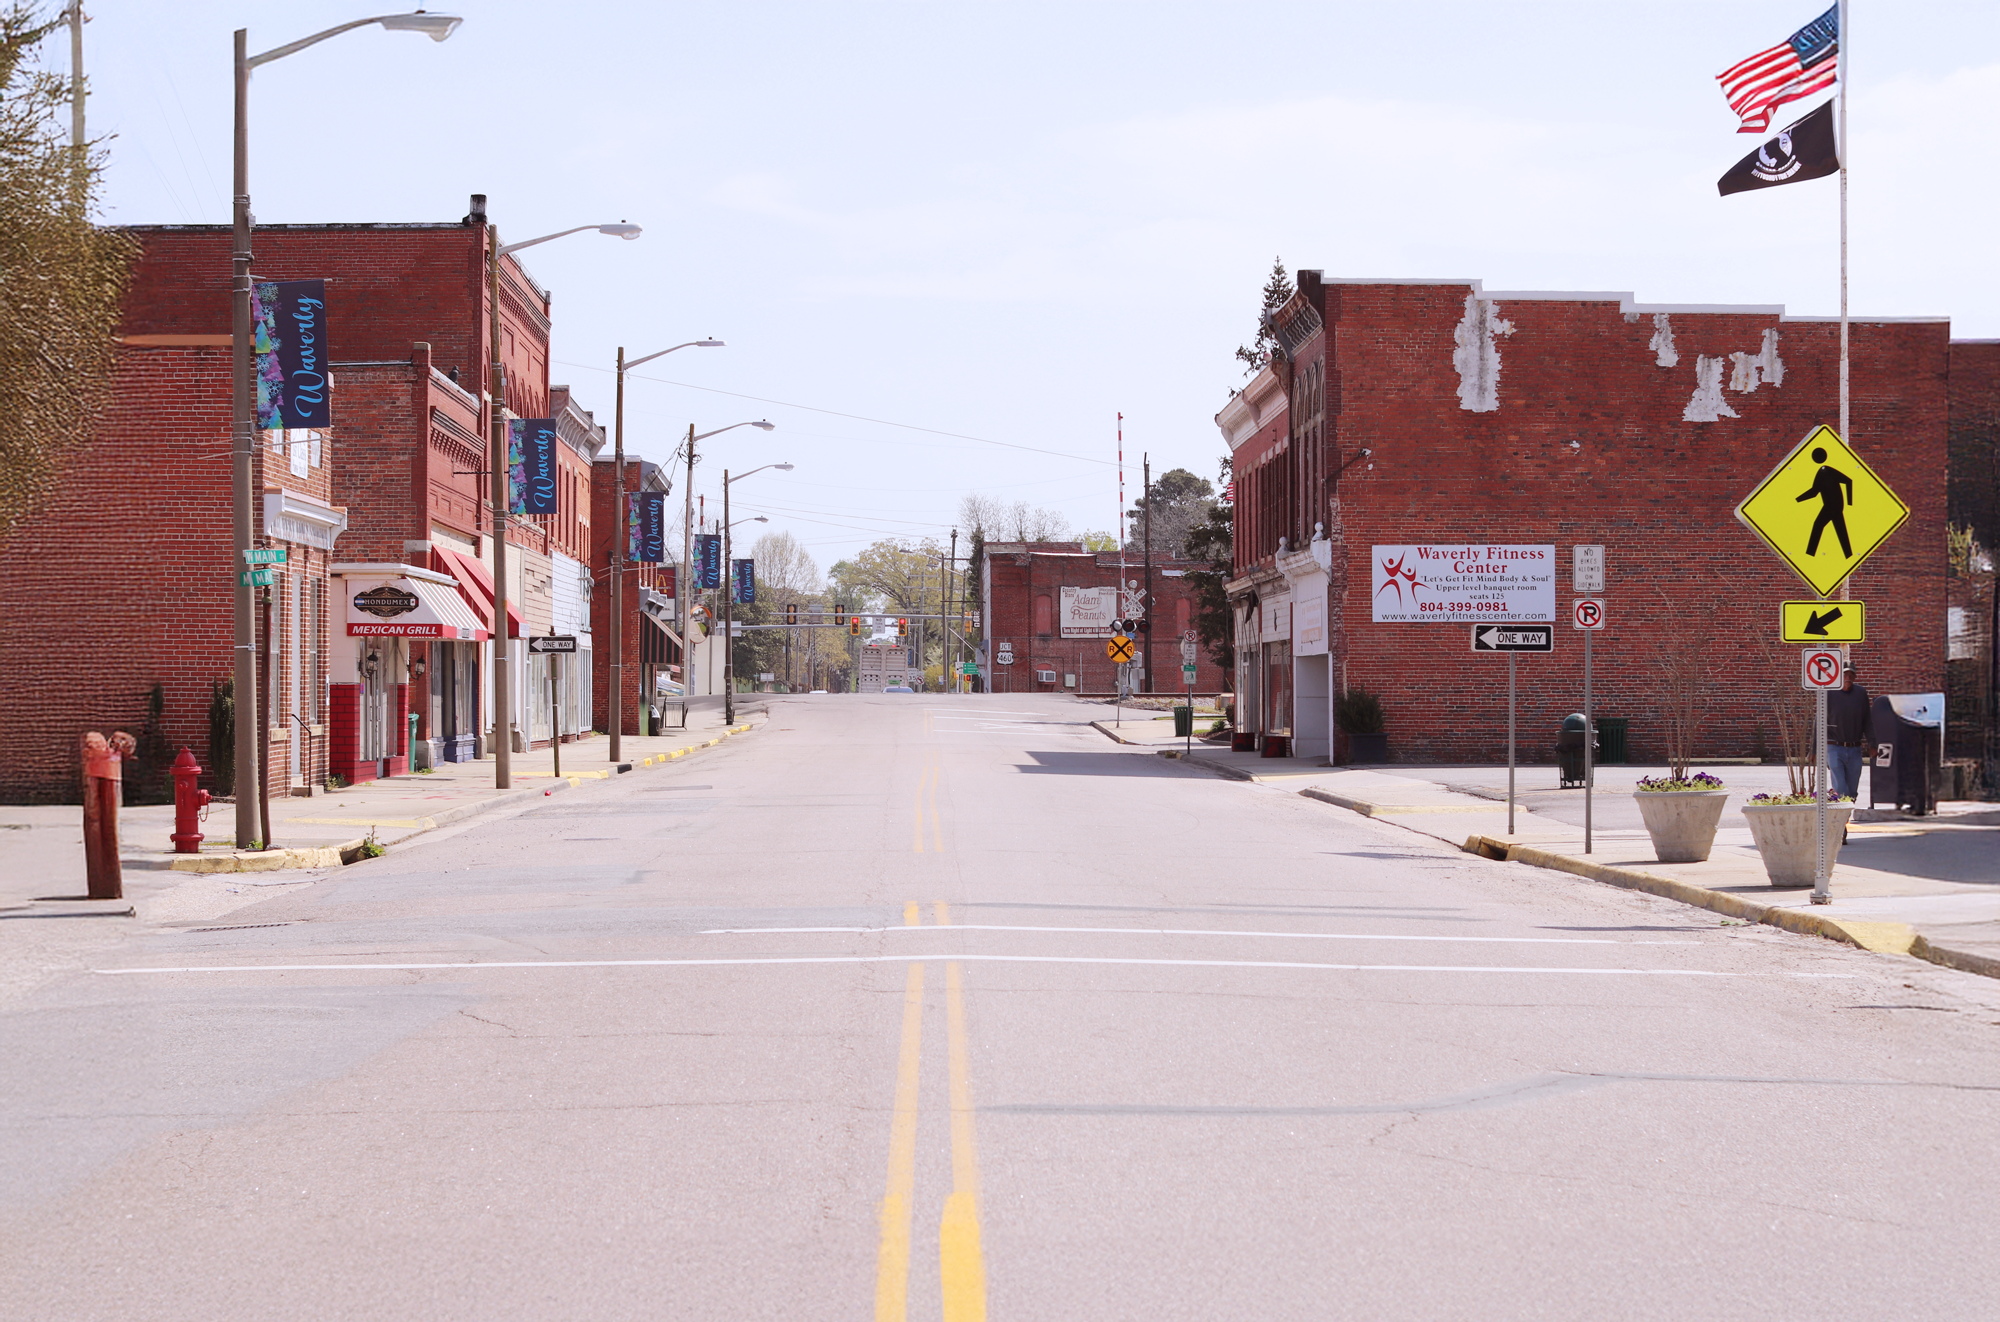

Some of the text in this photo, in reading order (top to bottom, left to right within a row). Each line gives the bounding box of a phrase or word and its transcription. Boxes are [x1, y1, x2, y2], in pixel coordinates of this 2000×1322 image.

[292, 294, 324, 418] Waverly
[532, 427, 556, 508] Waverly
[646, 498, 664, 558] Waverly
[246, 551, 254, 562] W
[254, 550, 277, 562] MAIN
[1416, 546, 1545, 561] Waverly Fitness
[706, 540, 720, 585] Waverly
[1453, 561, 1508, 574] Center
[744, 563, 754, 600] Waverly
[1446, 575, 1460, 583] Get
[1462, 575, 1474, 583] Fit
[1476, 575, 1497, 583] Mind
[1500, 575, 1518, 584] Body
[1436, 584, 1460, 592] Upper
[1462, 584, 1481, 592] level
[1484, 584, 1515, 592] banquet
[1420, 602, 1508, 612] 804-399-0981
[1071, 609, 1106, 620] Peanuts
[1381, 612, 1547, 622] www.waverlyfitnesscenter.com
[352, 626, 438, 635] MEXICAN GRILL
[1498, 633, 1544, 644] ONE WAY
[998, 654, 1012, 662] 460
